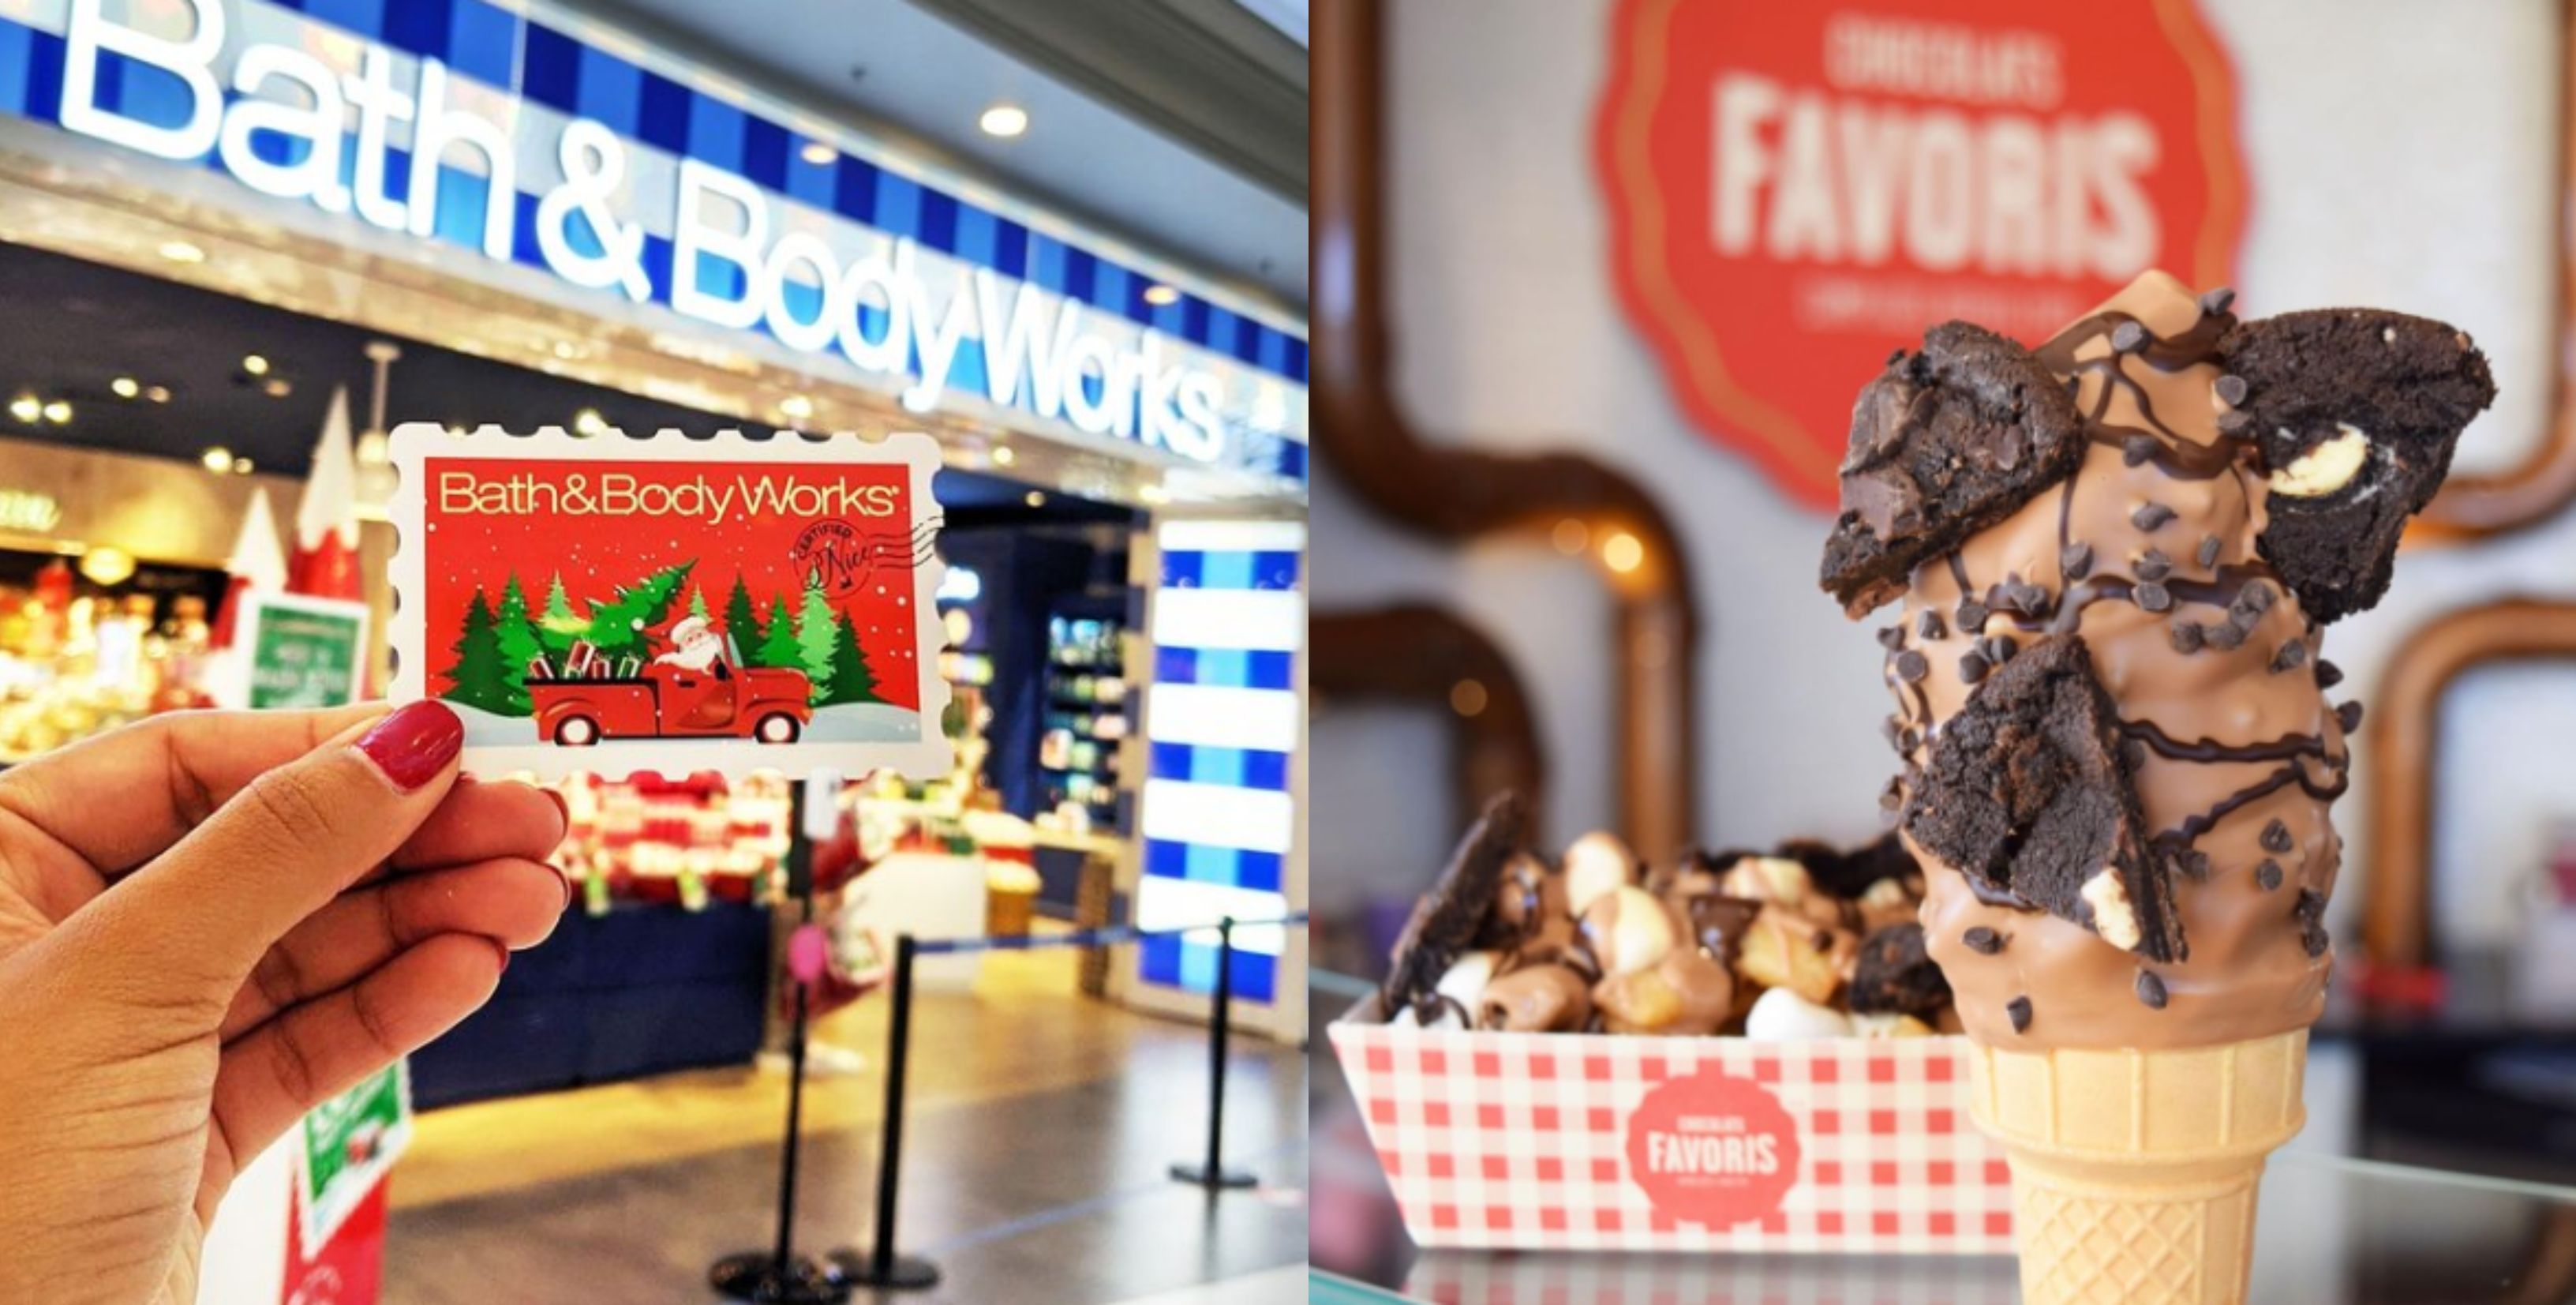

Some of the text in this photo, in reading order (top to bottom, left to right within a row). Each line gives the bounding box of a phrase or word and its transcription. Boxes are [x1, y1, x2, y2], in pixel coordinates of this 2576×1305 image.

[1710, 69, 2162, 279] FAVORIS
[59, 0, 1226, 461] Bath & Body Works
[736, 474, 895, 517] Works
[797, 523, 853, 561] CERTIFIED
[1647, 1130, 1778, 1176] FAVORIS
